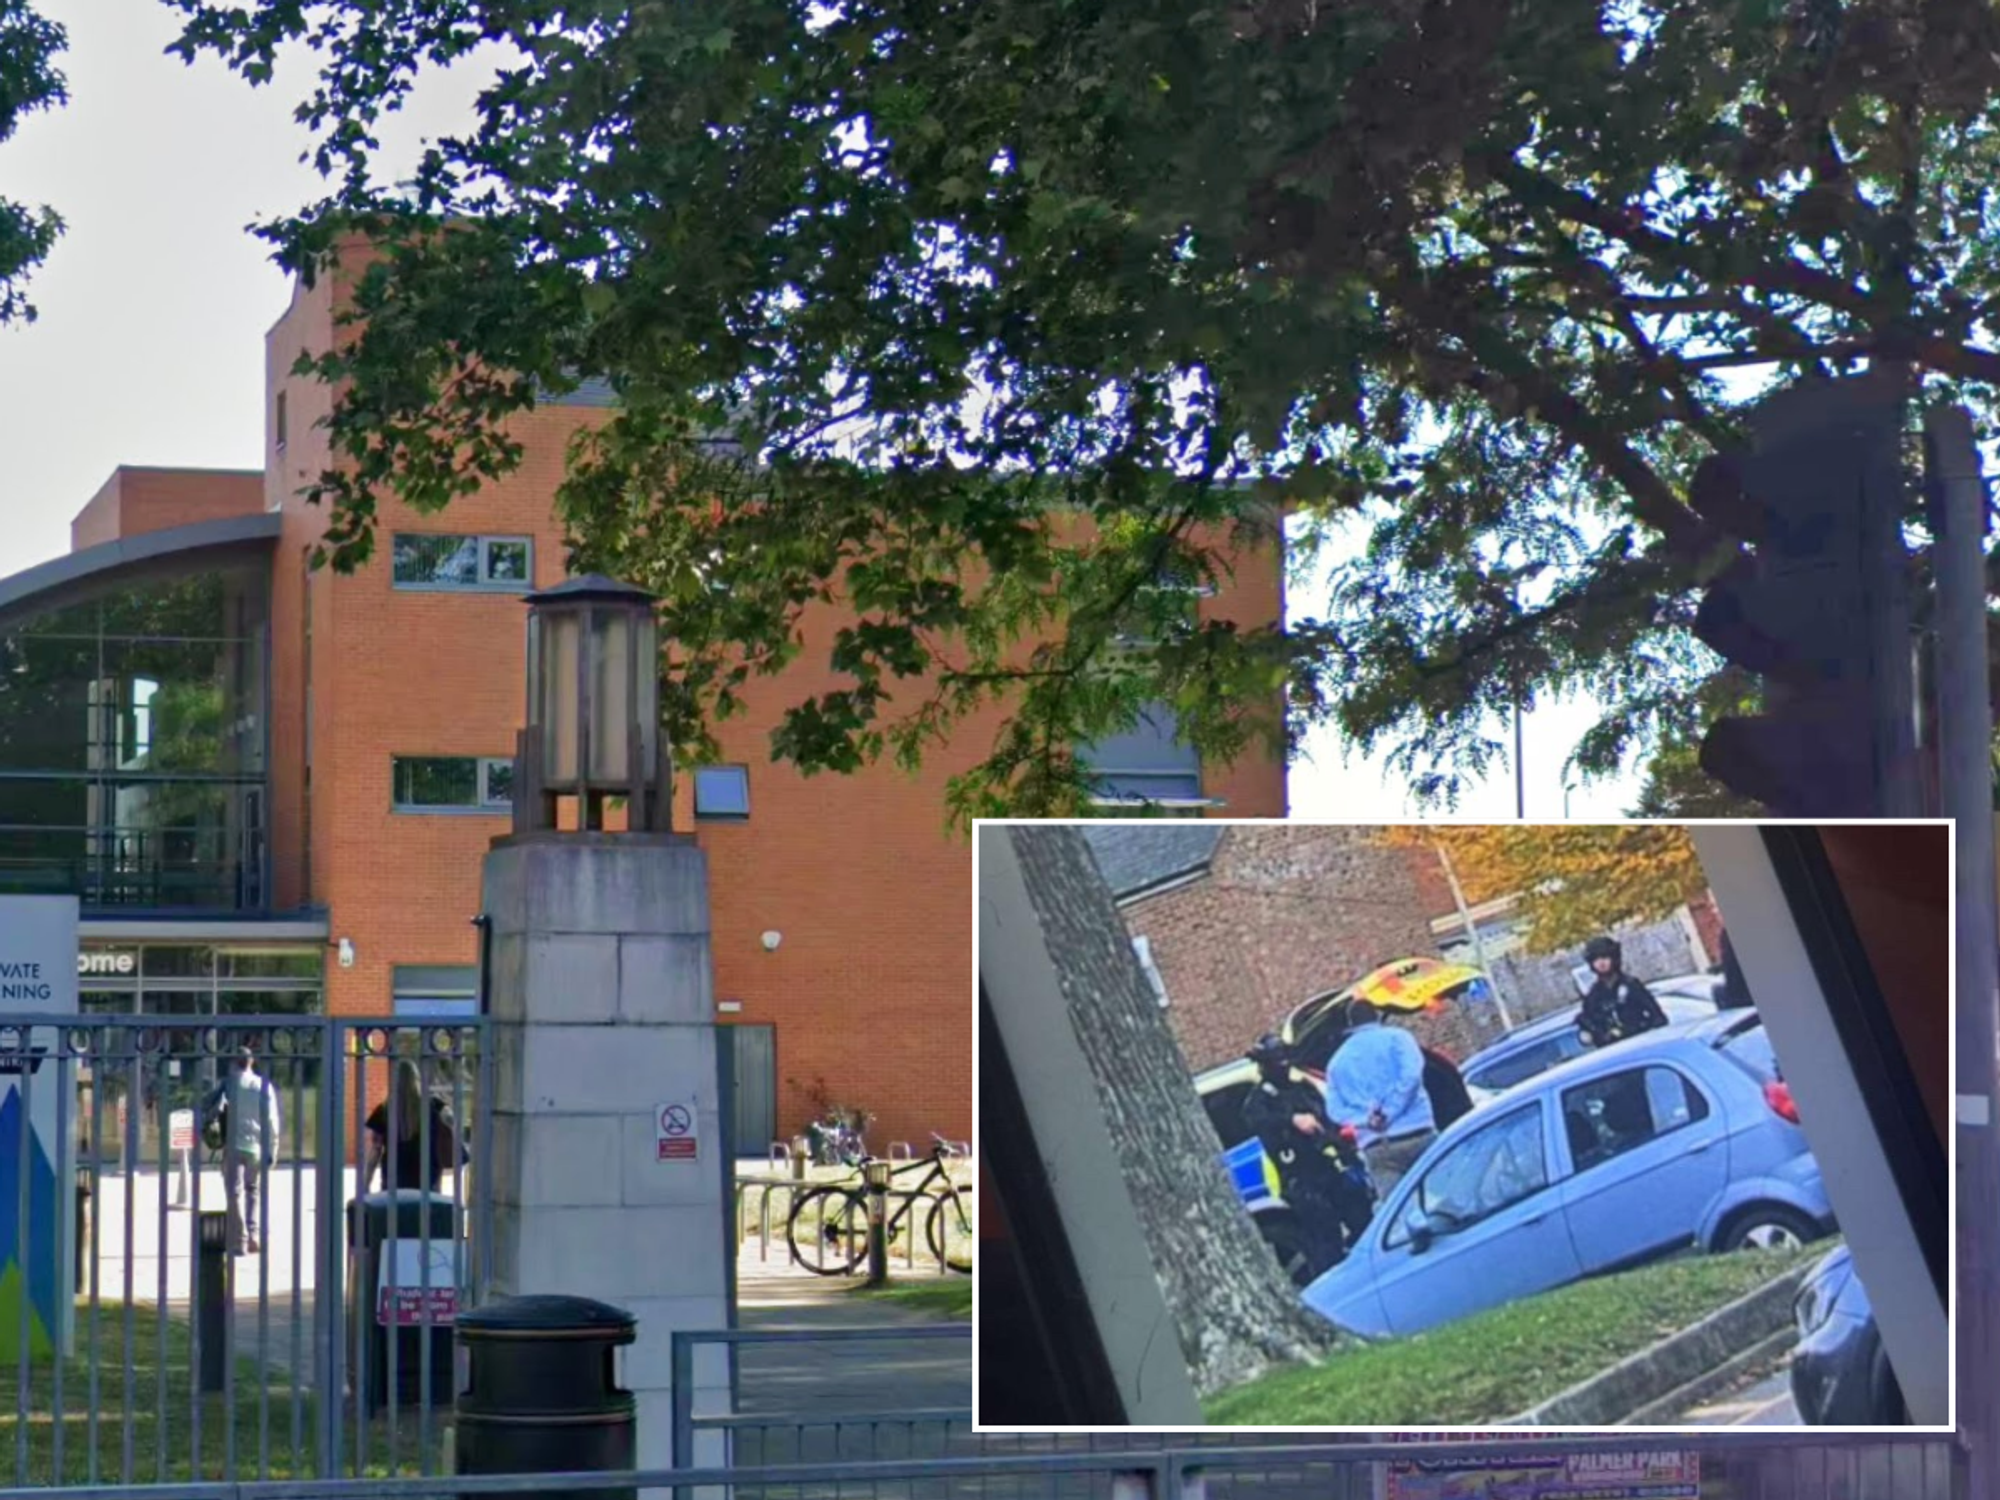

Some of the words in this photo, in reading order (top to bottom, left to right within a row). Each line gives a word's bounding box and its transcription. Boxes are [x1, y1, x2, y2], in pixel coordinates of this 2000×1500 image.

[2, 984, 51, 1000] NING
[1568, 1452, 1634, 1473] PALMER
[1637, 1450, 1683, 1470] PARK
